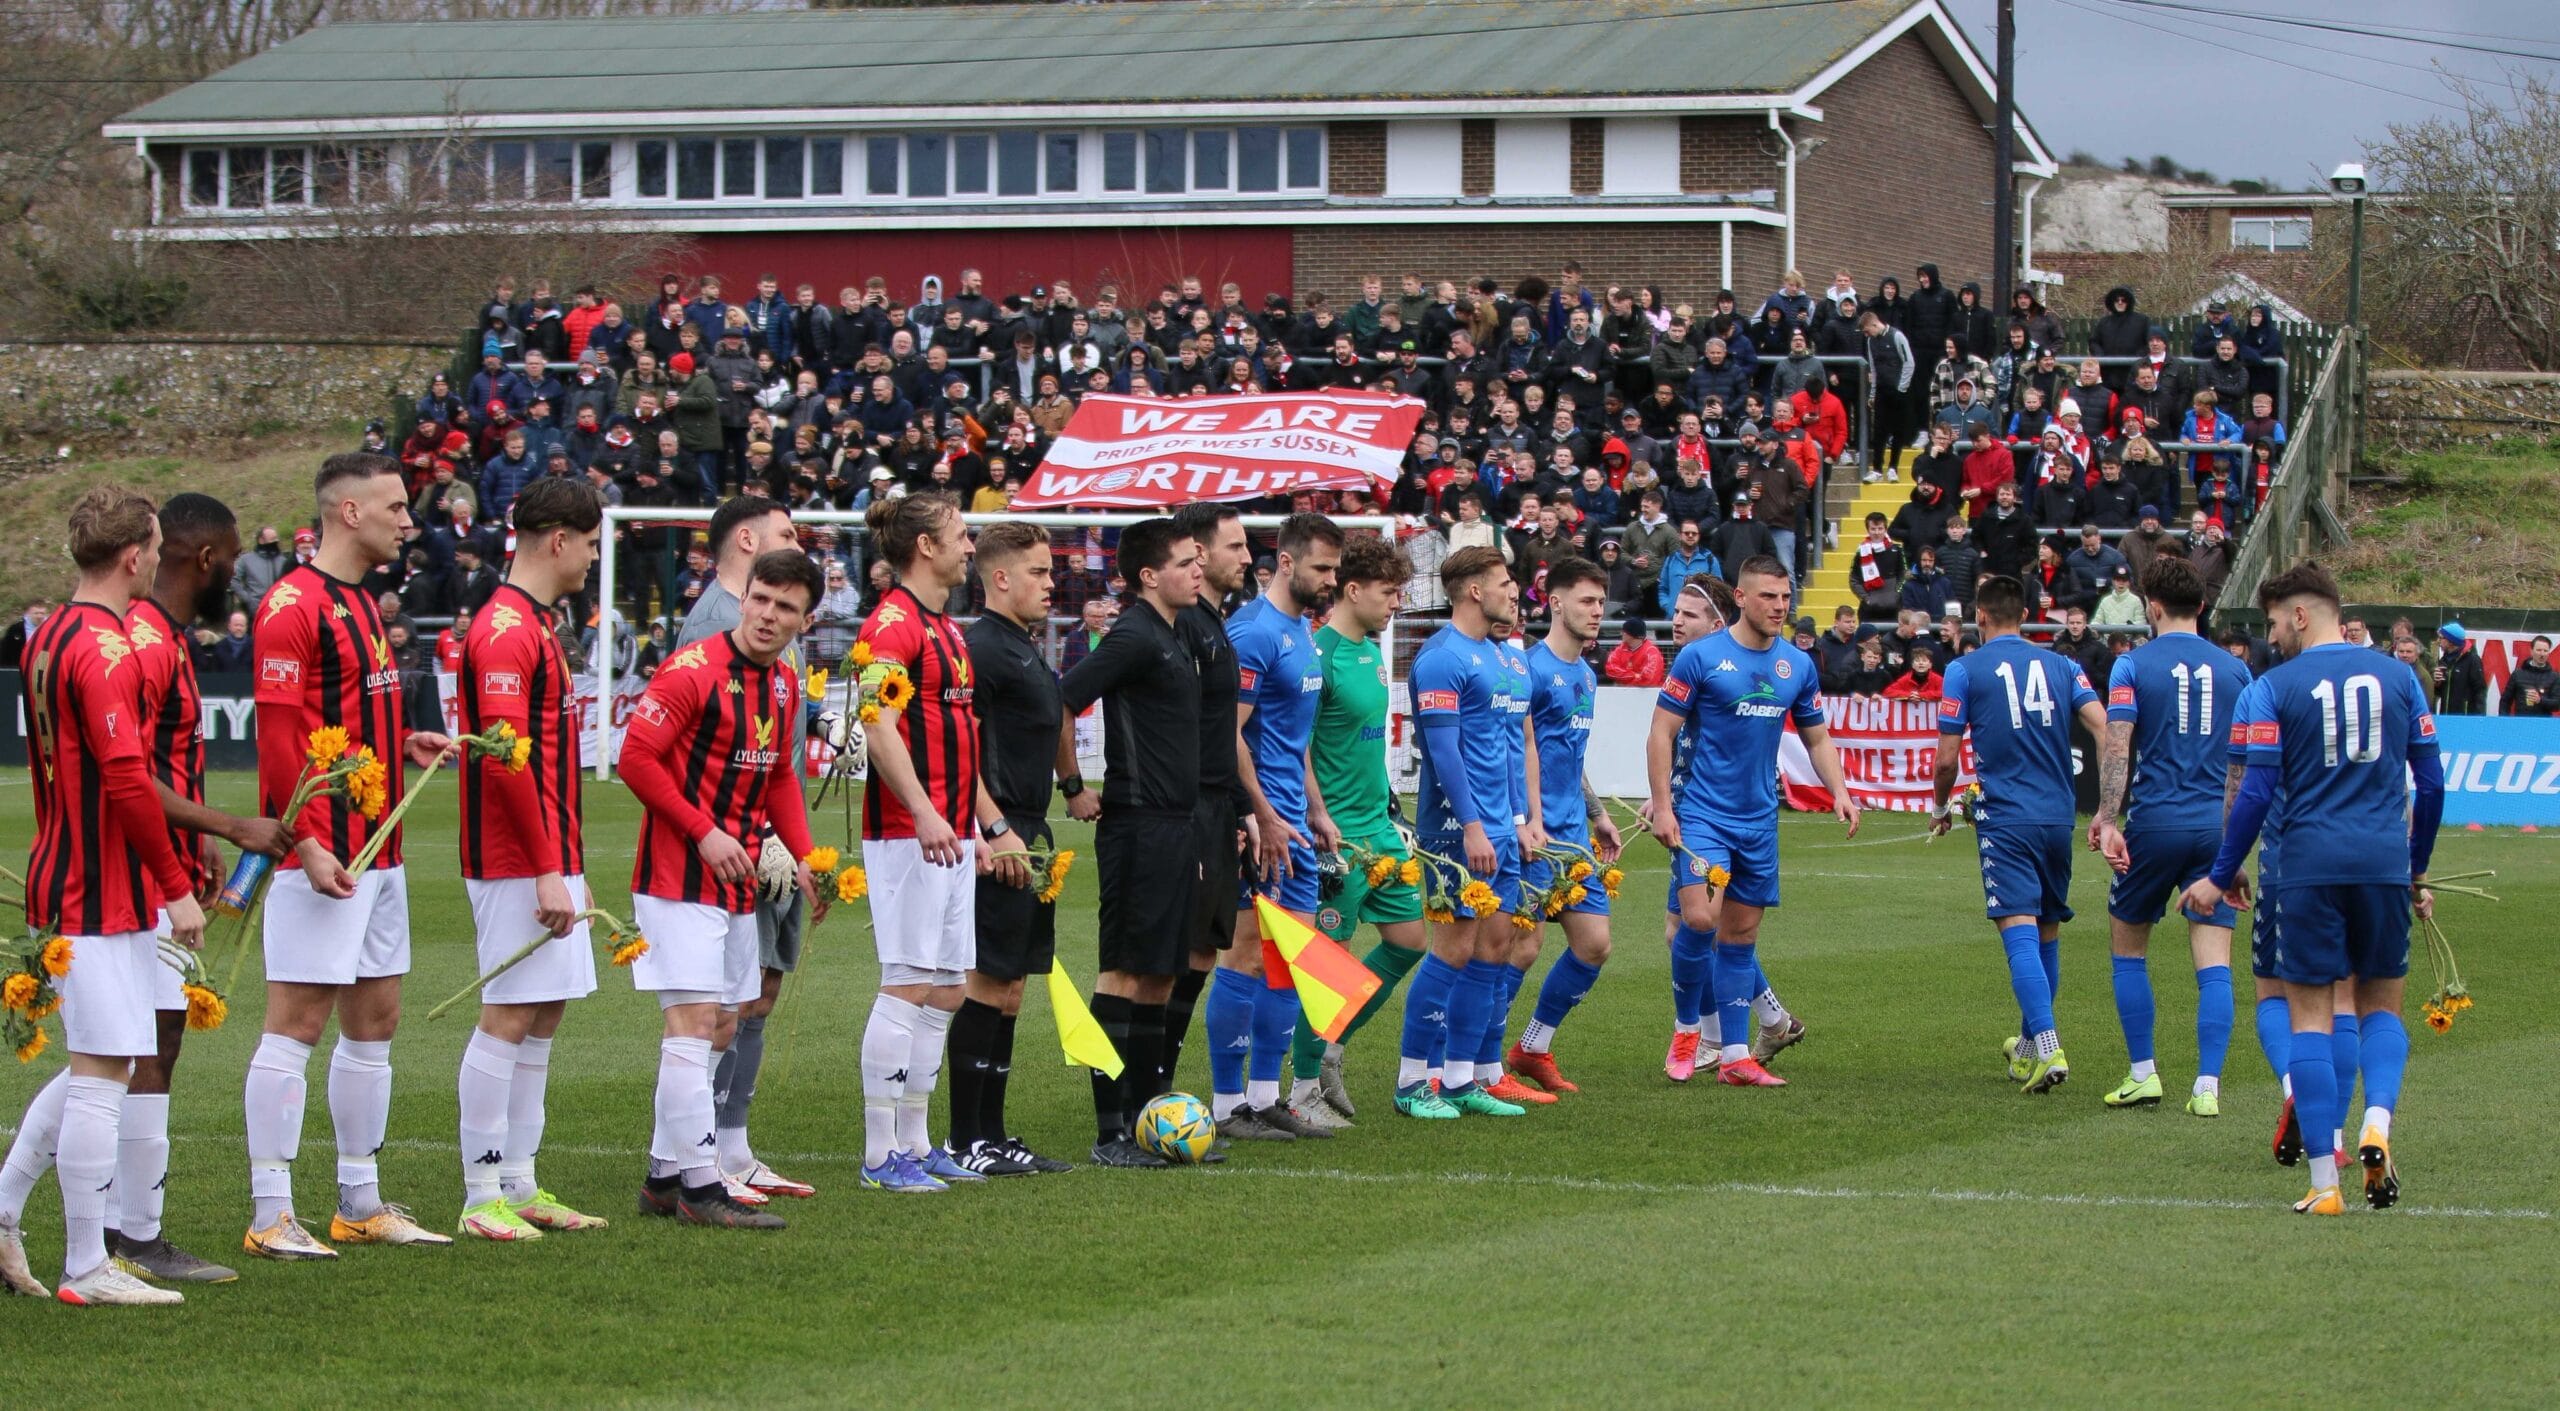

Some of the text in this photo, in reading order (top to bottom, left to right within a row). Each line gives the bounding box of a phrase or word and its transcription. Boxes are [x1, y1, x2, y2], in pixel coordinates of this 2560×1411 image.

[1121, 405, 1383, 440] WE ARE
[1094, 434, 1359, 461] PRIDE OF WEST SUSSEX
[268, 661, 295, 673] PITCHING
[1735, 701, 1786, 717] RABBIT
[1822, 696, 1941, 731] WORTHI
[1994, 659, 2055, 729] 14
[2171, 662, 2213, 736] 11
[200, 696, 256, 740] TY
[2311, 674, 2383, 768] 10
[1904, 738, 1976, 783] 186
